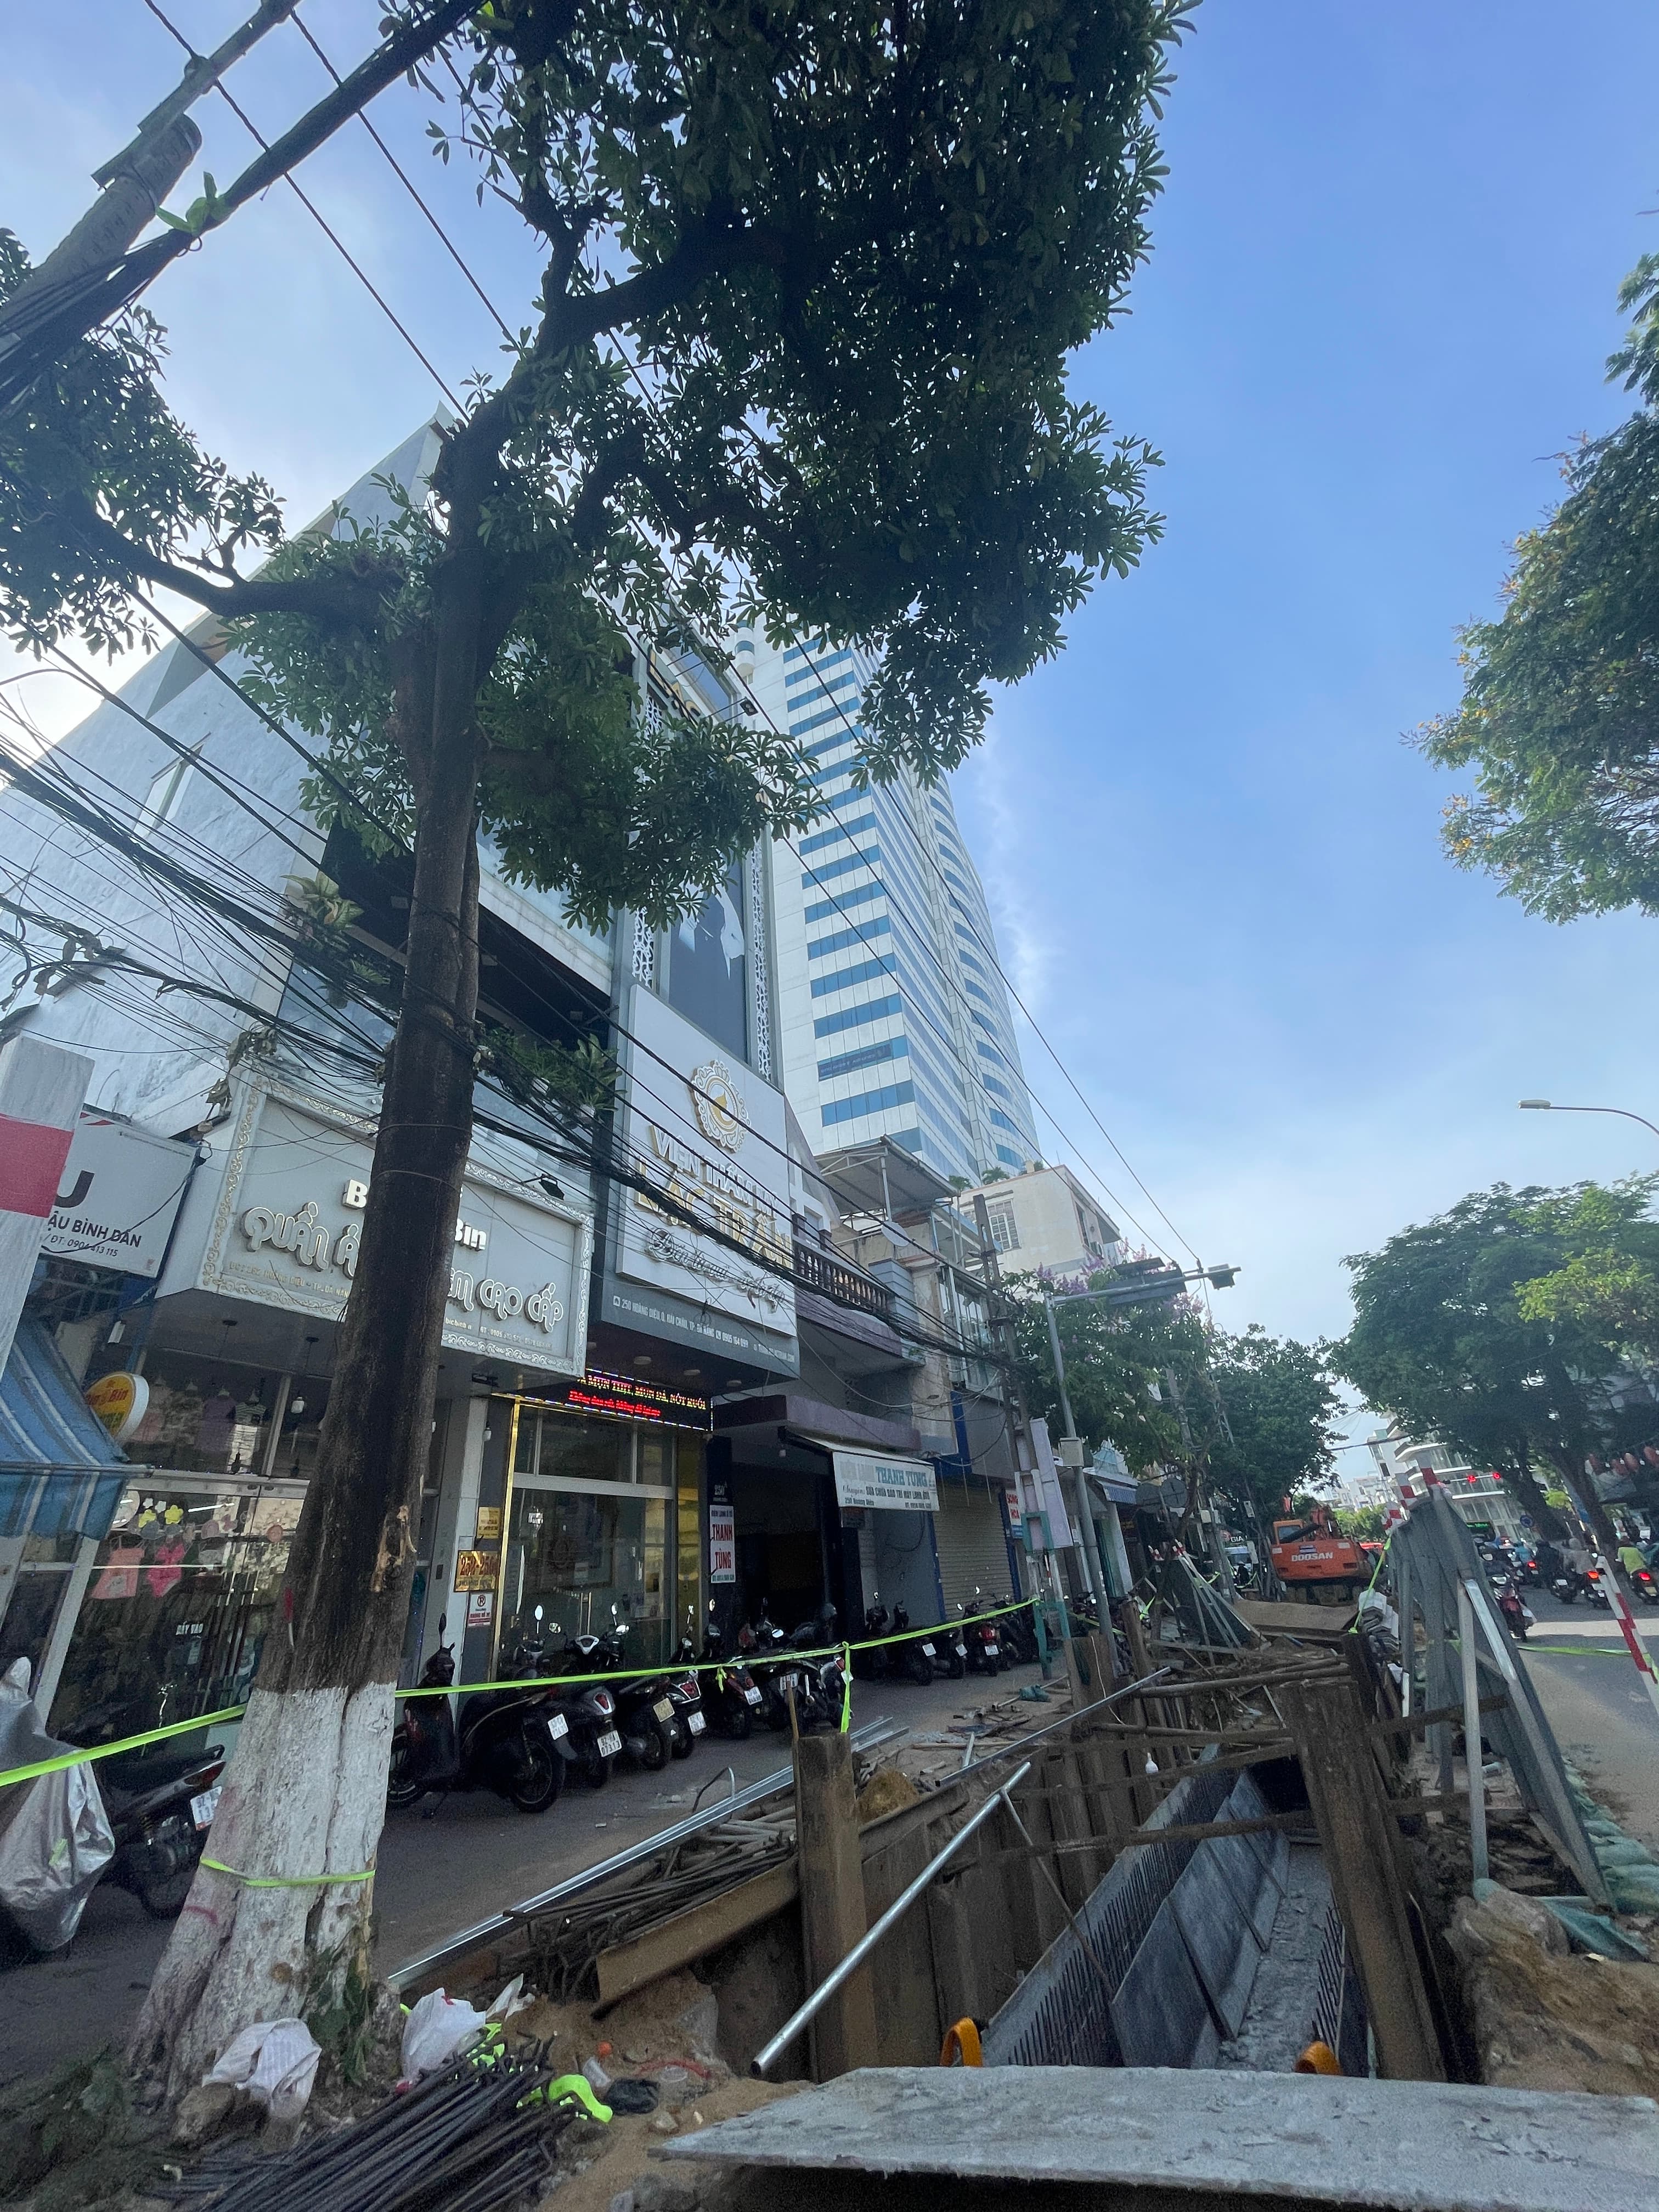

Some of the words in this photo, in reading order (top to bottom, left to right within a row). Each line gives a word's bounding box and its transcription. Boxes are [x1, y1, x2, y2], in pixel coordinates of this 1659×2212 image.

[651, 1125, 700, 1178] VIỆN
[703, 1156, 753, 1206] THẨM
[48, 1211, 70, 1231] ẬU
[72, 1218, 109, 1239] BÌNH
[110, 1228, 142, 1248] DÂN
[106, 1248, 118, 1257] 115
[334, 1223, 360, 1278] Á
[622, 1299, 631, 1311] 250
[632, 1302, 648, 1316] HOÀNG
[712, 1524, 733, 1541] THANH
[715, 1547, 731, 1569] TÙNG
[1291, 1552, 1334, 1562] DOOSAN
